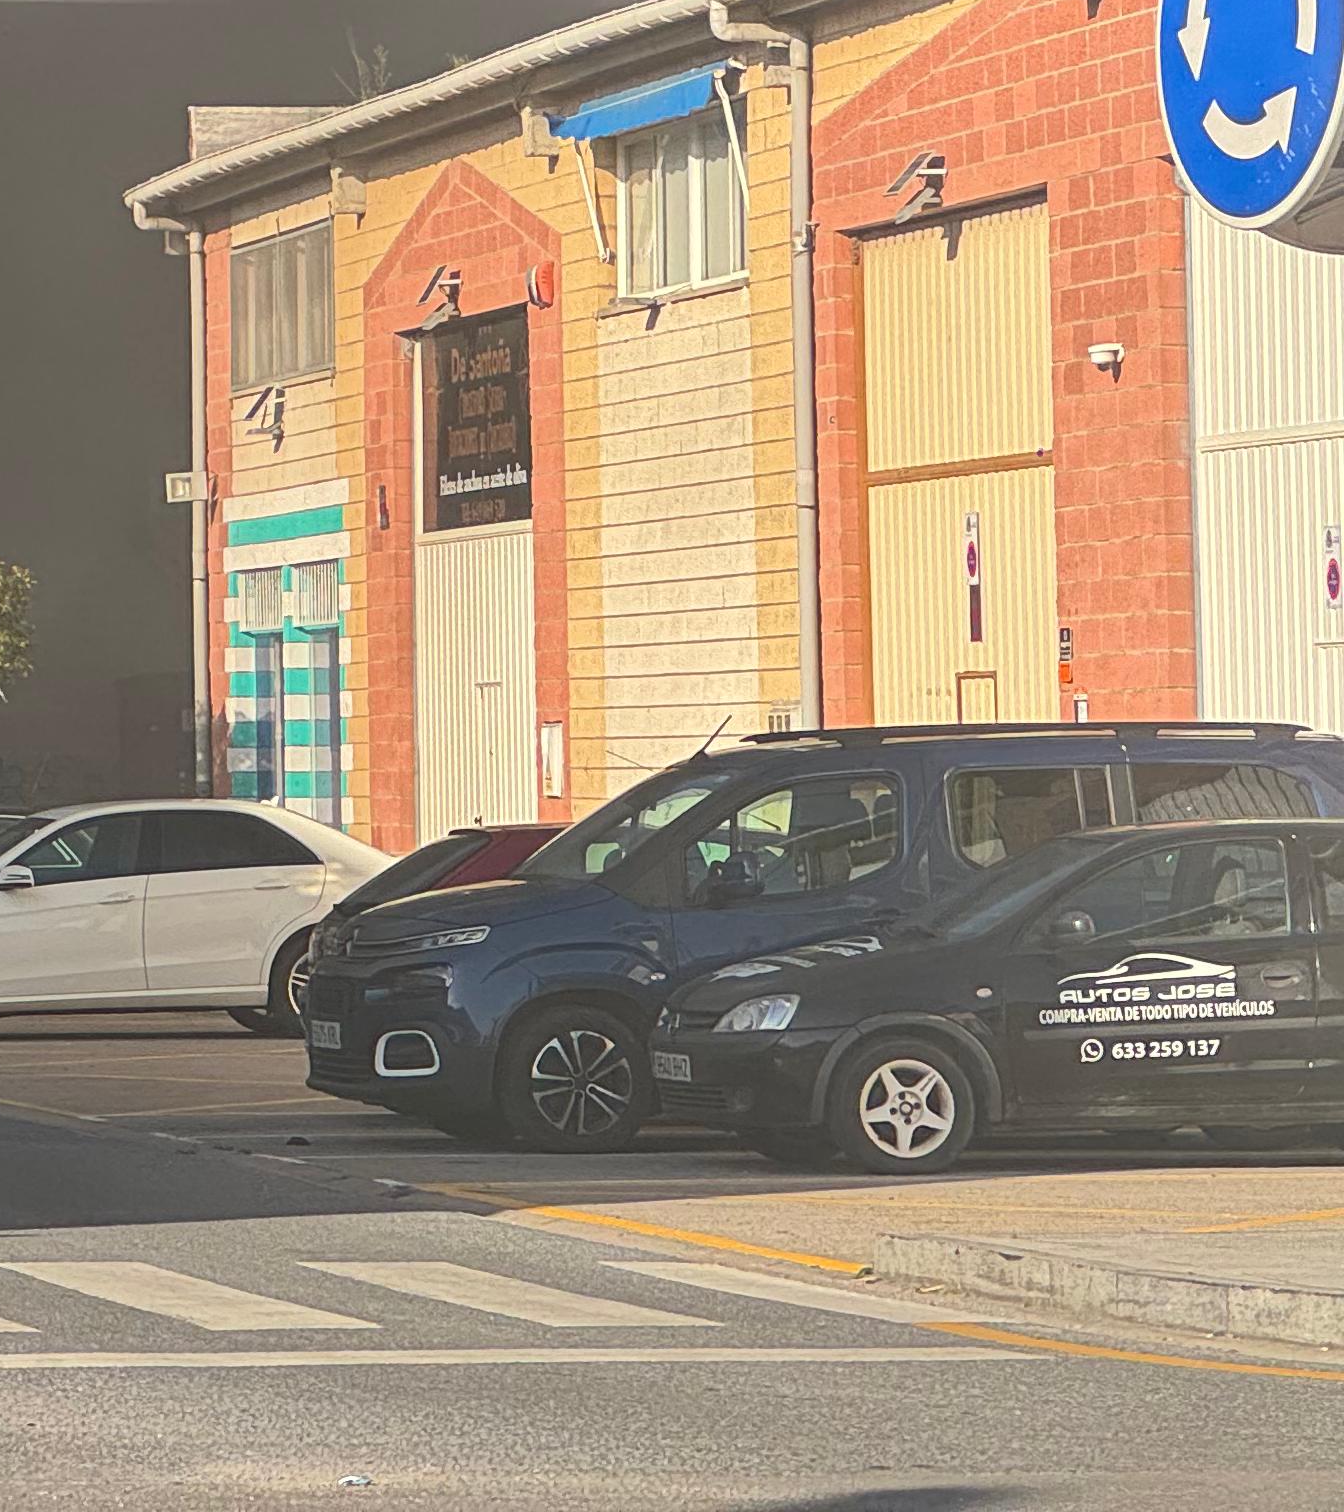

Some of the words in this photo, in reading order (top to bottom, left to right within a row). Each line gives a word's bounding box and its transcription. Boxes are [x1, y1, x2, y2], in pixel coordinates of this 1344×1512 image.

[1059, 986, 1151, 1004] AUTOS
[1157, 983, 1236, 1000] JOSE
[1039, 1007, 1124, 1024] COMPRA-VENTA
[1125, 1007, 1141, 1022] DE
[1141, 1005, 1172, 1021] TODO
[1172, 1004, 1197, 1020] TIPO
[1198, 1002, 1215, 1019] DE
[1215, 999, 1275, 1017] VEHÍCULOS
[1112, 1042, 1146, 1059] 633
[1149, 1040, 1184, 1058] 259
[1187, 1039, 1220, 1056] 137
